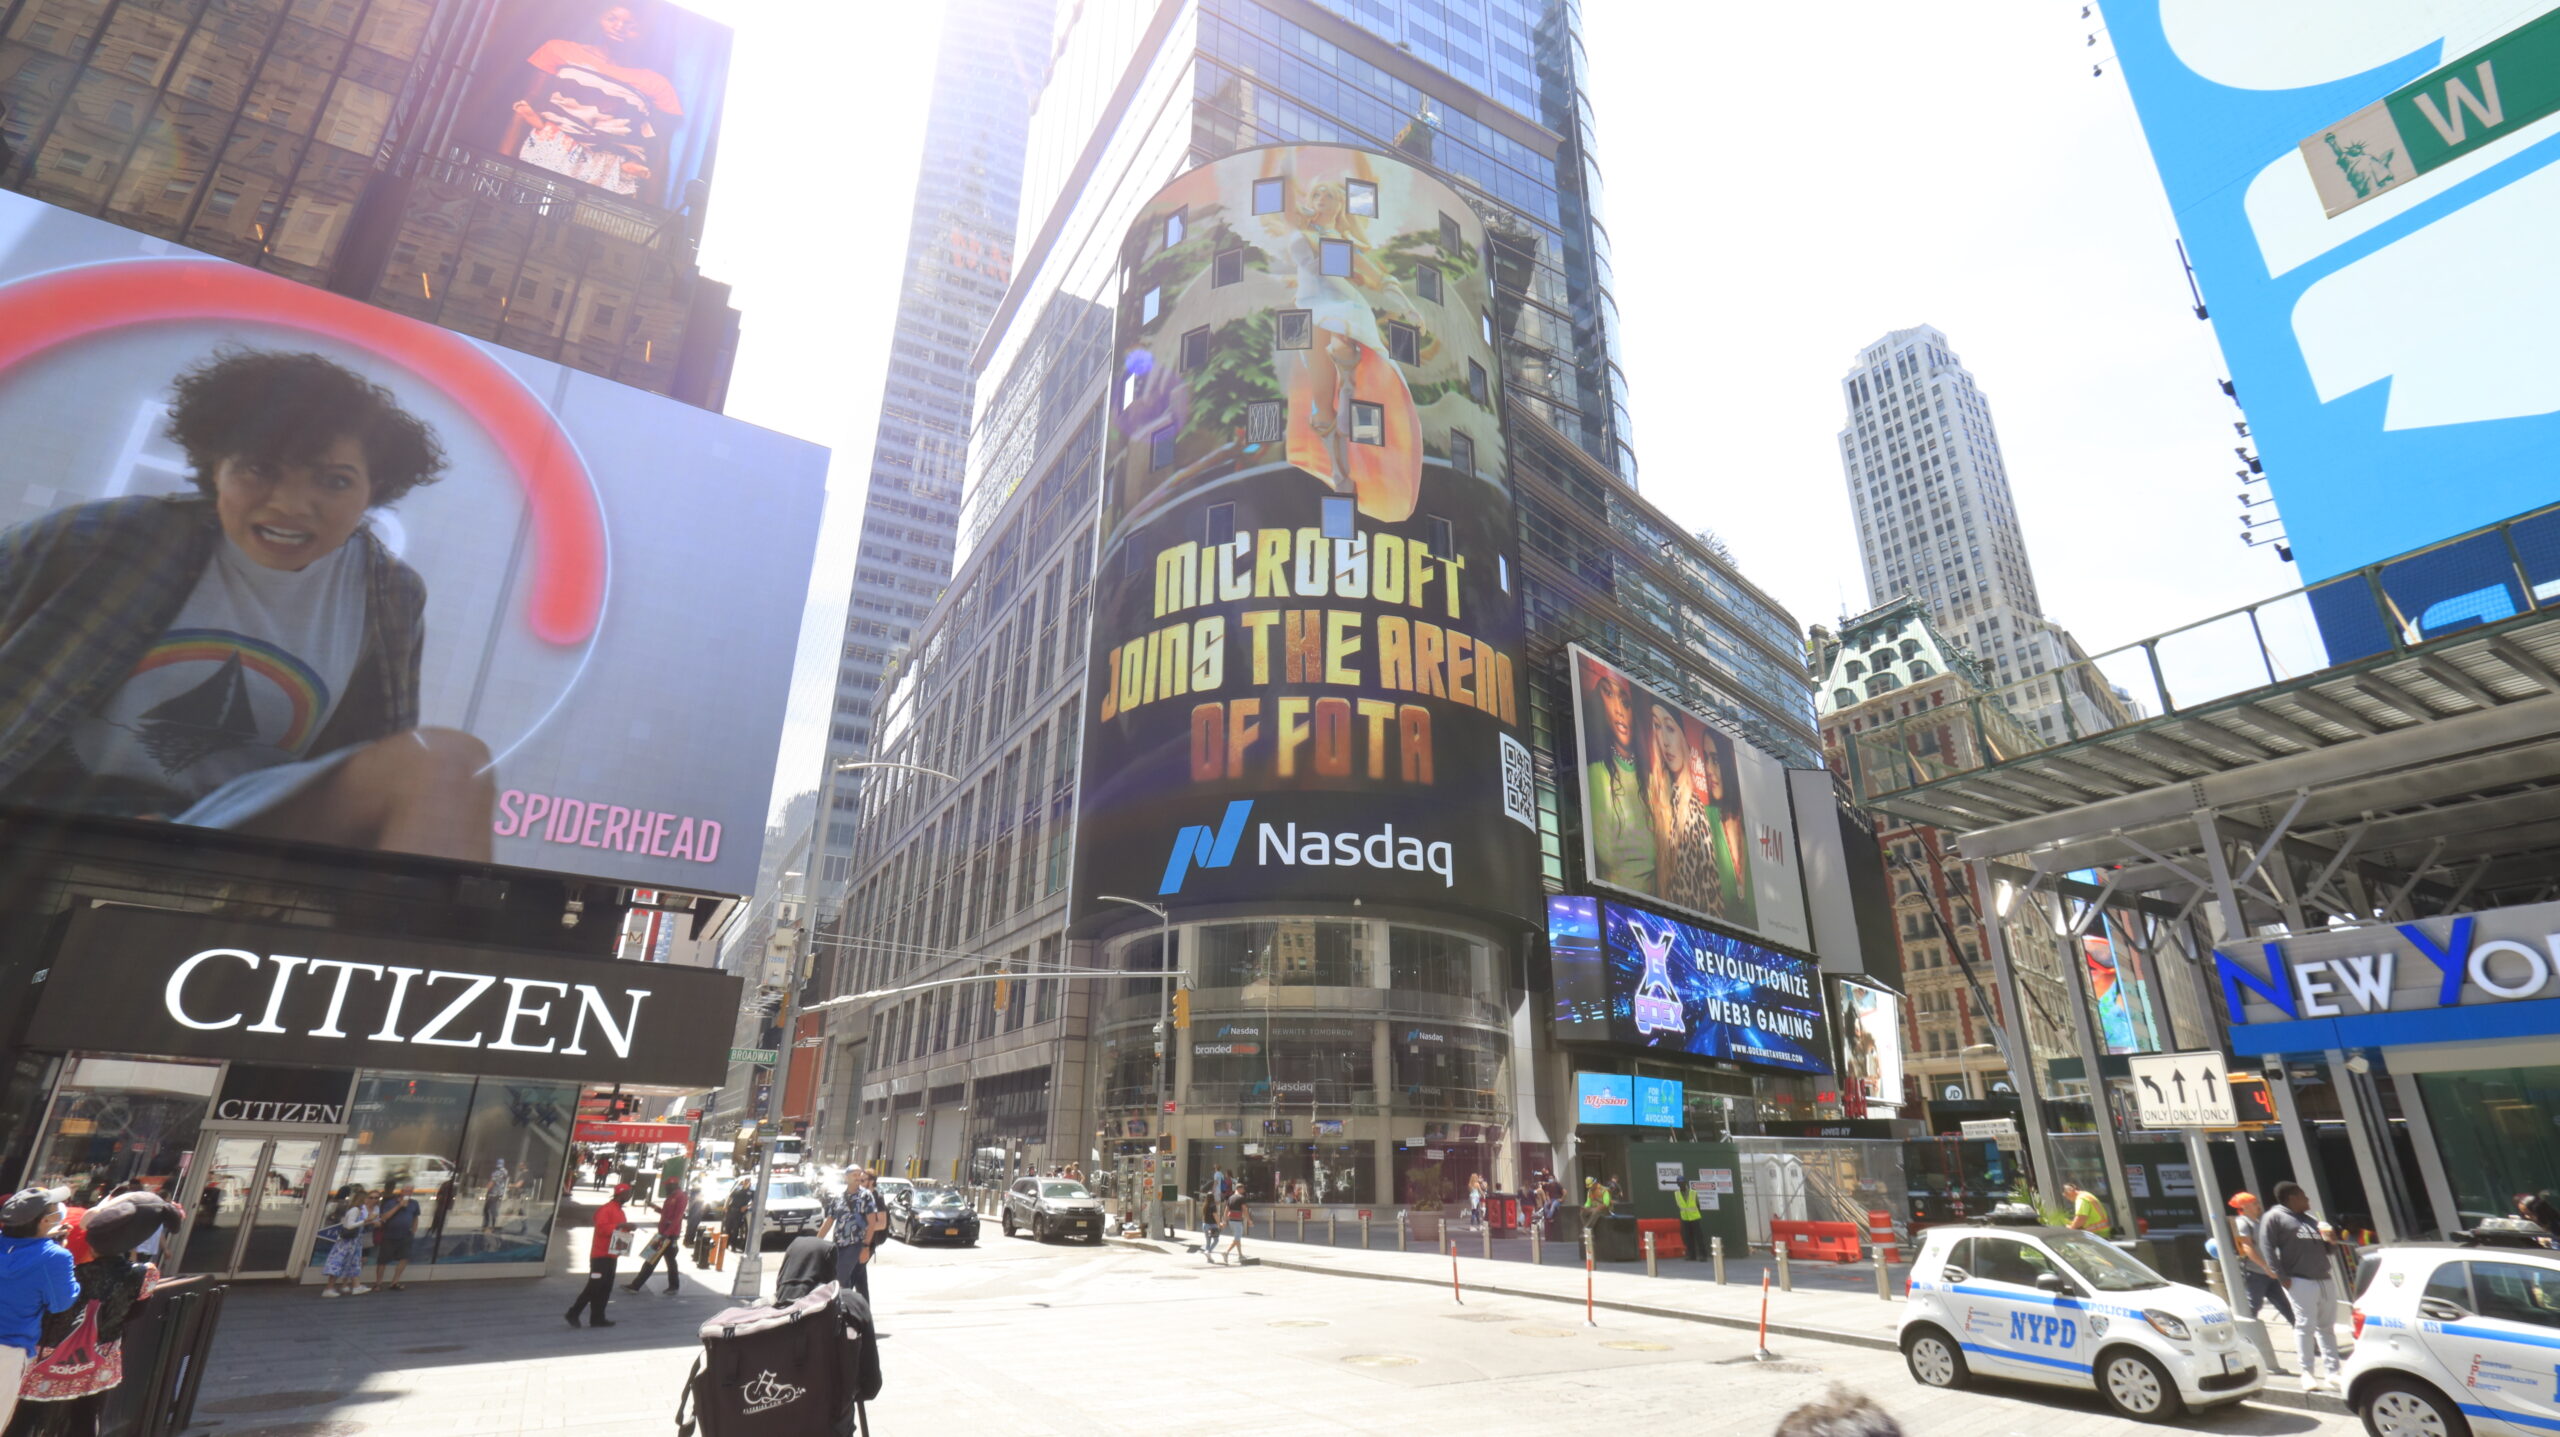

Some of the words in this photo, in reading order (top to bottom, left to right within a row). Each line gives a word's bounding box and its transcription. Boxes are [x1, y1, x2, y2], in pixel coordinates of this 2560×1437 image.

[2413, 60, 2504, 147] W
[1154, 527, 1465, 619] MICROSOFT
[1101, 615, 1226, 724] JOINS
[1241, 609, 1361, 686] THE
[1377, 614, 1517, 727] ARENA
[1191, 697, 1261, 782] OF
[1277, 696, 1434, 786] FOTA
[494, 789, 722, 863] SPIDERHEAD
[1257, 822, 1454, 888] Nasdaq
[1695, 948, 1810, 999] REVOLUTIONIZE
[164, 948, 652, 1059] CITIZEN
[1707, 997, 1751, 1028] WEB3
[1757, 1009, 1813, 1040] GAMING
[1230, 1026, 1259, 1037] Nasdaq
[1419, 1033, 1444, 1043] Nasdaq
[731, 1050, 775, 1062] BROADWAY
[1272, 1081, 1314, 1093] Nasdaq
[1584, 1094, 1629, 1108] Mission
[218, 1099, 344, 1124] CITIZEN
[2144, 1110, 2168, 1121] ONLY
[2173, 1110, 2198, 1121] ONLY
[2204, 1109, 2229, 1121] ONLY
[2088, 1302, 2130, 1317] POLICE
[2010, 1311, 2077, 1349] NYPD
[48, 1361, 95, 1375] adidas
